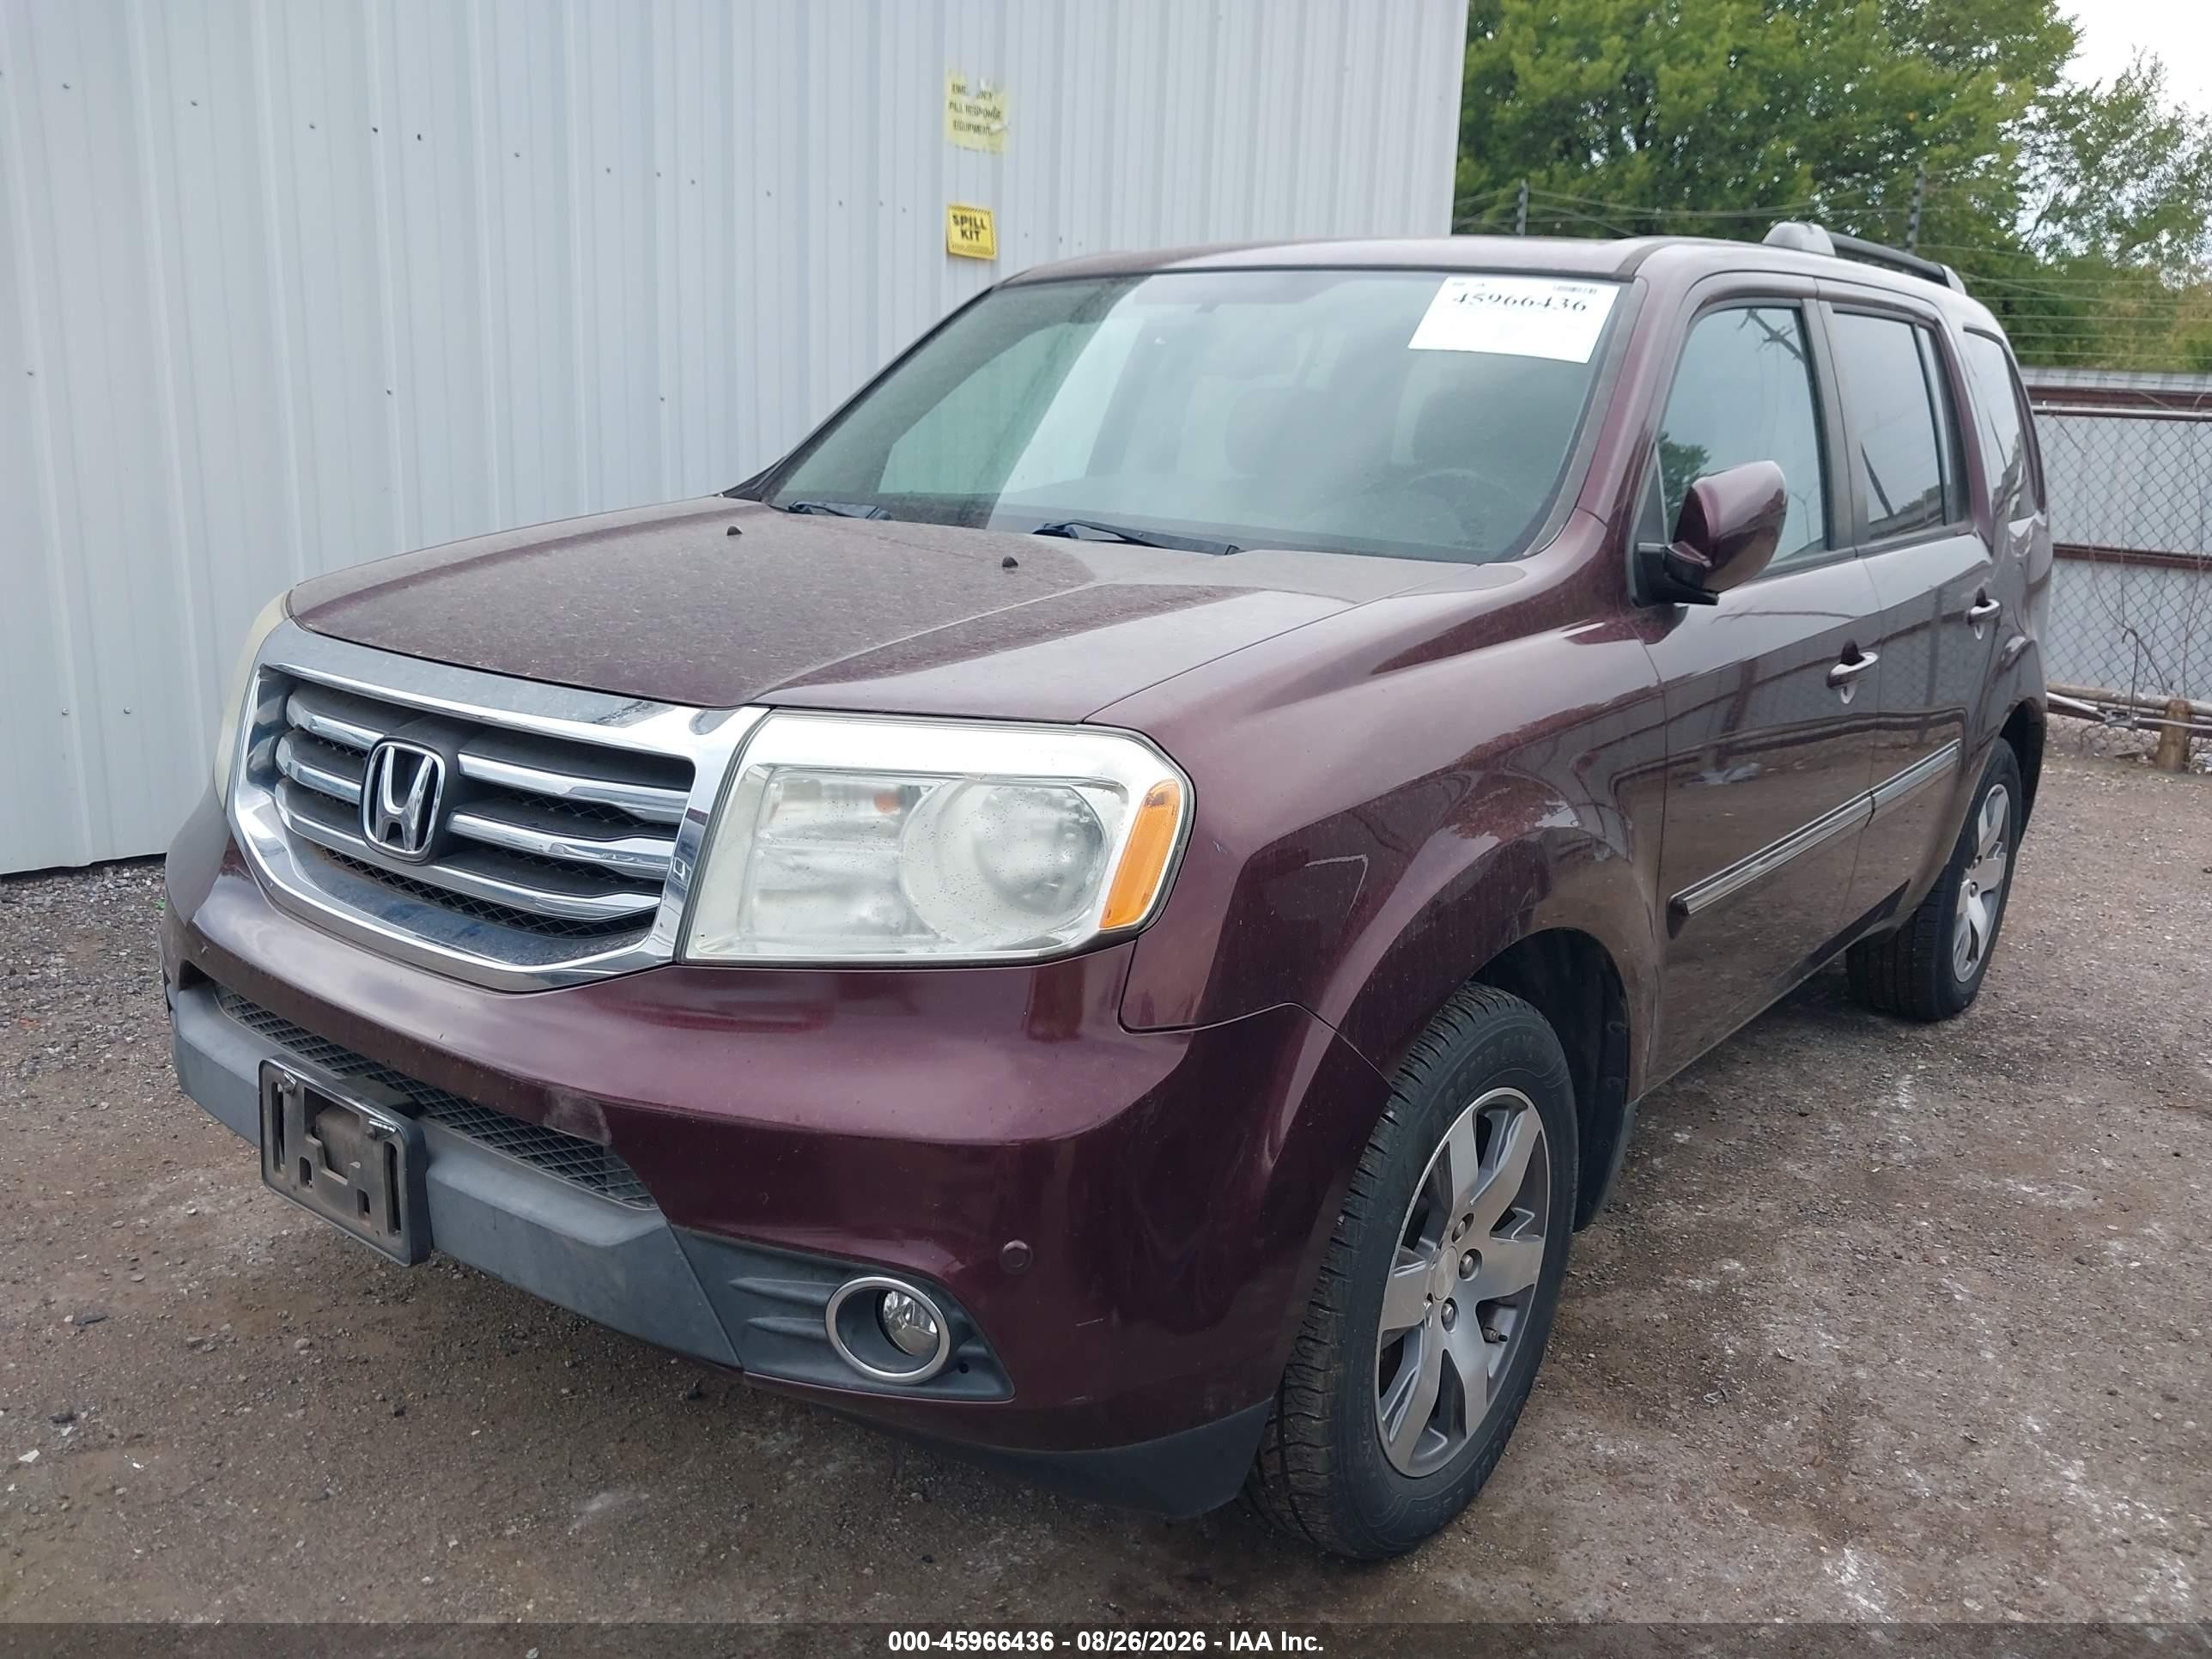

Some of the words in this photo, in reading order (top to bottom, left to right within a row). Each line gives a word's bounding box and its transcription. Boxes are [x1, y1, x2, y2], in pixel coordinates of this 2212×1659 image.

[952, 213, 988, 231] SPILL
[961, 229, 981, 242] KIT
[1452, 291, 1588, 313] 45966436
